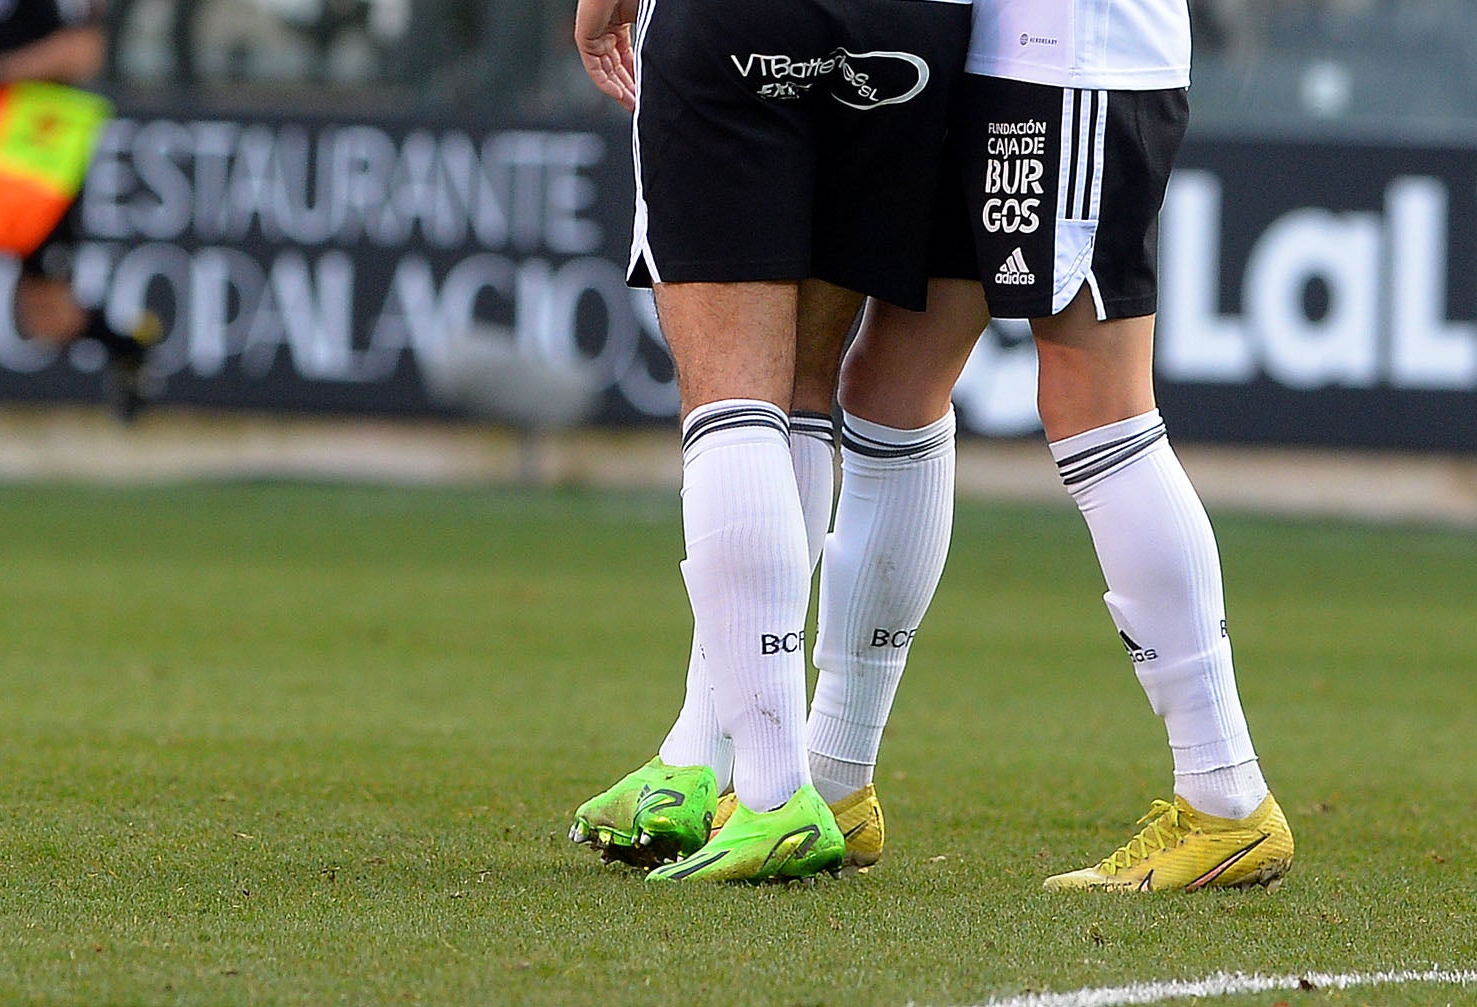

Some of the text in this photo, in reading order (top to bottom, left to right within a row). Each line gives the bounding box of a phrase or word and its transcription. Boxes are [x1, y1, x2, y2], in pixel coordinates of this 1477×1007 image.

[858, 85, 880, 102] SL
[987, 119, 1047, 135] FUNDACIÓN
[987, 136, 1046, 159] CAJA DE
[81, 117, 608, 255] ESTAURANTE
[984, 159, 1044, 194] BUR
[982, 198, 1041, 233] GOS
[994, 272, 1036, 285] adidas
